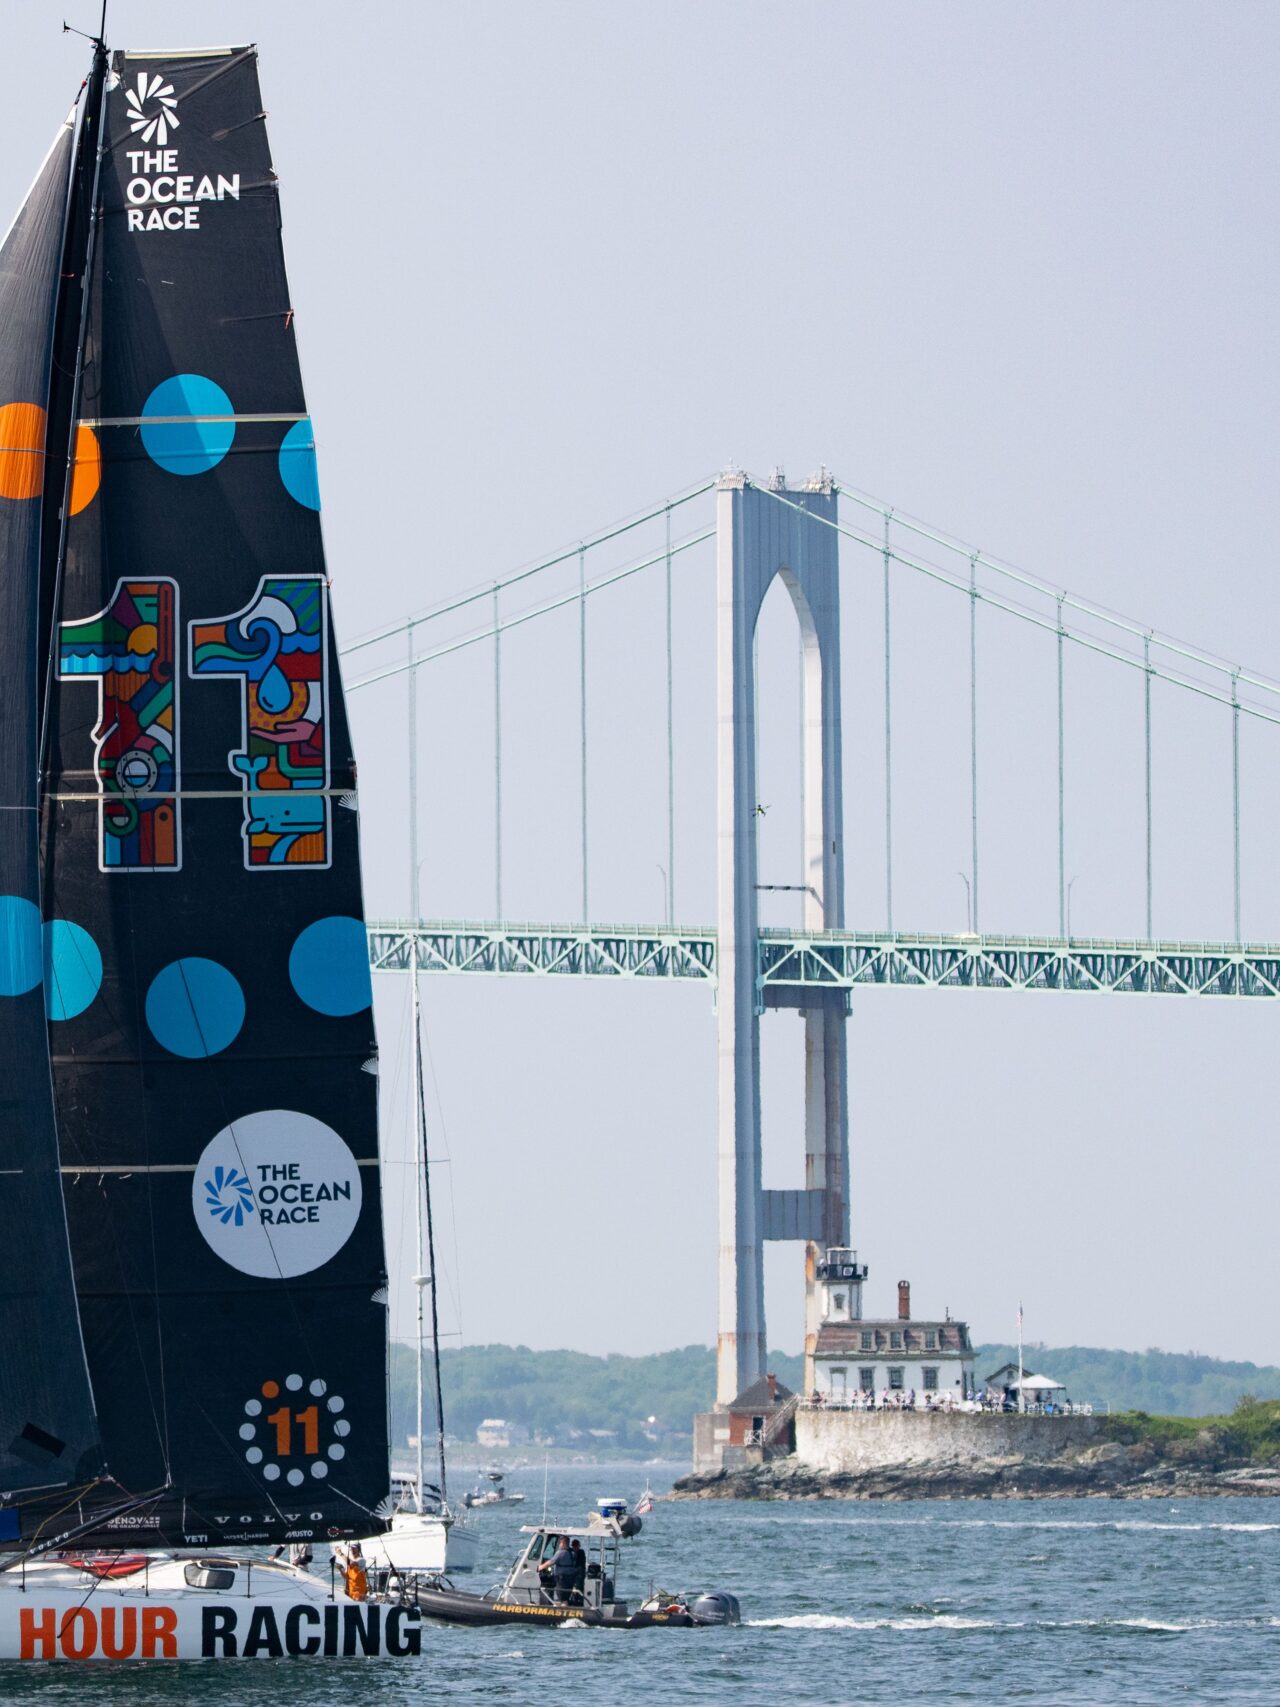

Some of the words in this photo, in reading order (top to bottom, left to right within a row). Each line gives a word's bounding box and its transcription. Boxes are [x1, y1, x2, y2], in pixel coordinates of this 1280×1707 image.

[126, 150, 179, 174] THE
[126, 174, 241, 204] OCEAN
[128, 206, 200, 232] RACE
[55, 576, 332, 873] 11
[257, 1163, 301, 1182] THE
[258, 1181, 351, 1204] OCEAN
[260, 1206, 320, 1225] RACE
[267, 1405, 319, 1456] 11
[213, 1512, 323, 1524] VOLVO
[29, 1532, 69, 1554] VOLVO
[184, 1534, 208, 1543] YETI
[285, 1530, 313, 1538] MUSTO
[492, 1604, 584, 1618] HARBORMASTER
[20, 1606, 178, 1660] HOUR
[201, 1604, 421, 1658] RACING
